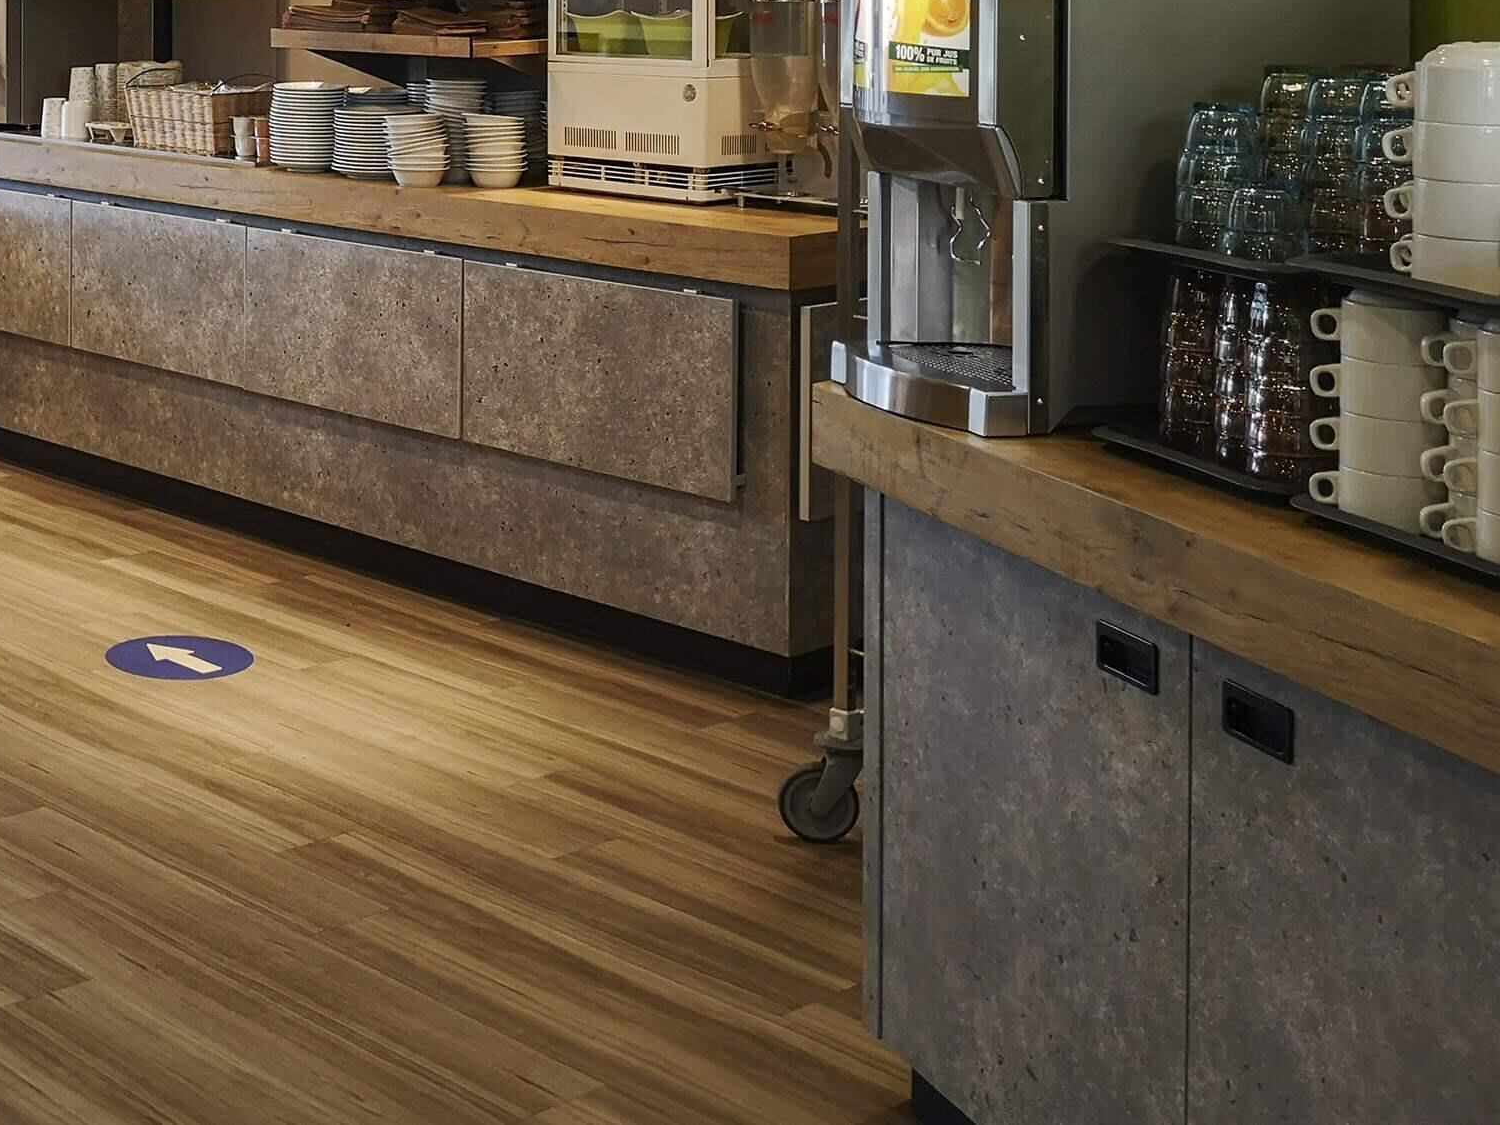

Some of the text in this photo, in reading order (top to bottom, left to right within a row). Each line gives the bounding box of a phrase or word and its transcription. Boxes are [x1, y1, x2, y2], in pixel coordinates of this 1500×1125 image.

[895, 44, 925, 62] 100%
[926, 48, 959, 59] PUR JUS
[936, 57, 958, 65] FRUITS
